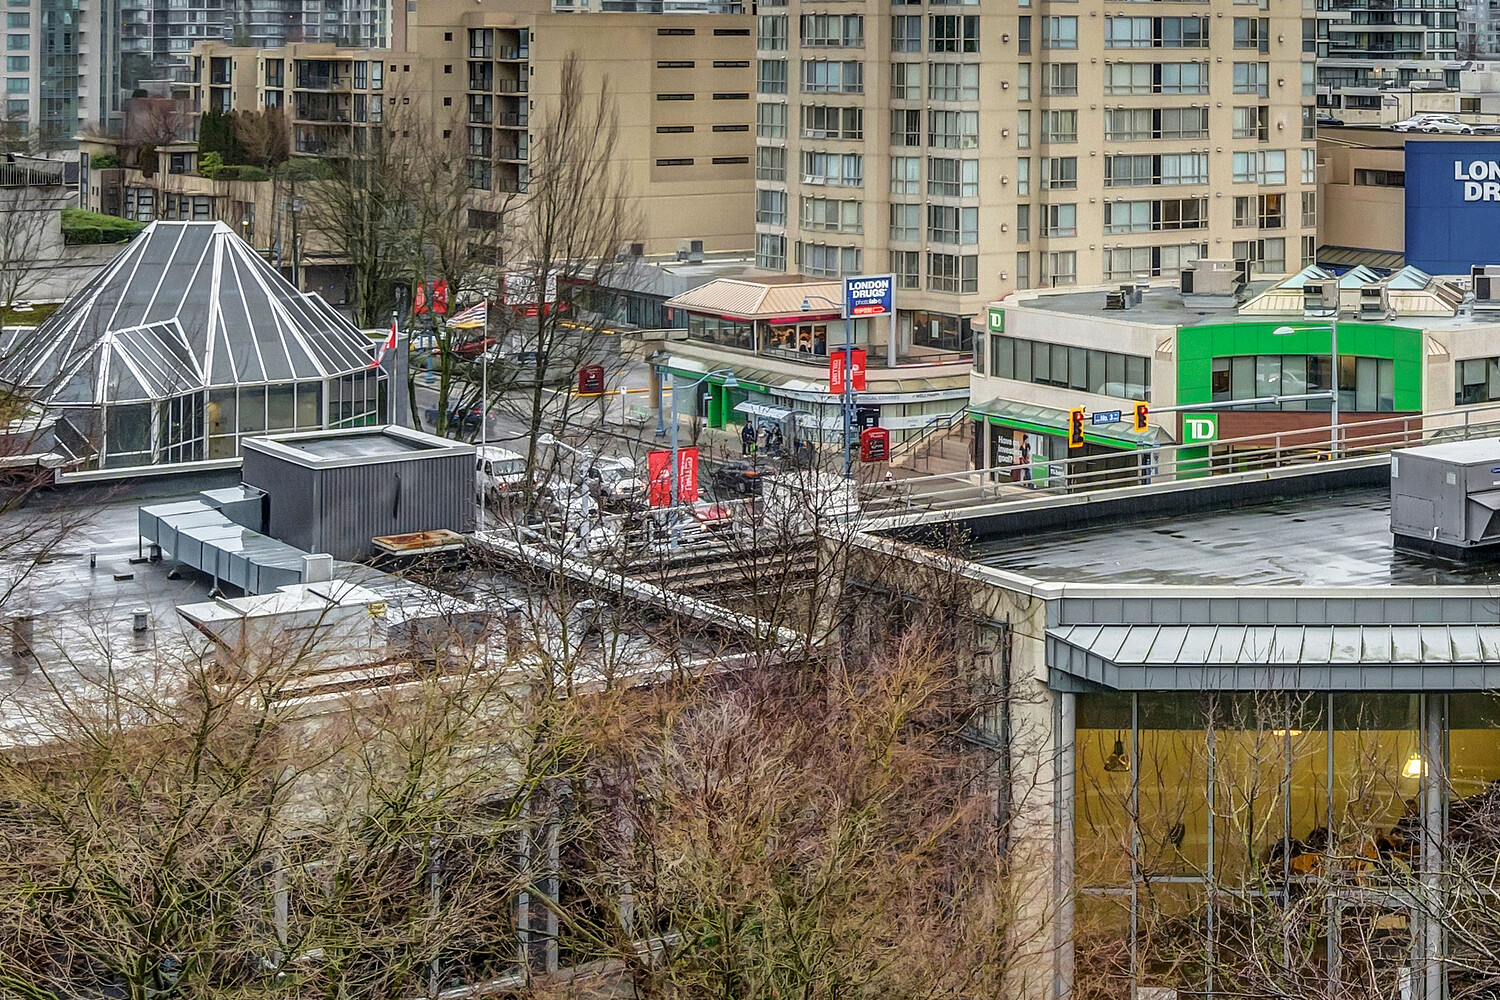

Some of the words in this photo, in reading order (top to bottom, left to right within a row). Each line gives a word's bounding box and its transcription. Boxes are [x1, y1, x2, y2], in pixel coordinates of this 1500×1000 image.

[849, 280, 889, 290] LONDON
[852, 288, 886, 299] DRUGS
[989, 312, 1002, 328] TD
[1185, 418, 1215, 440] TD
